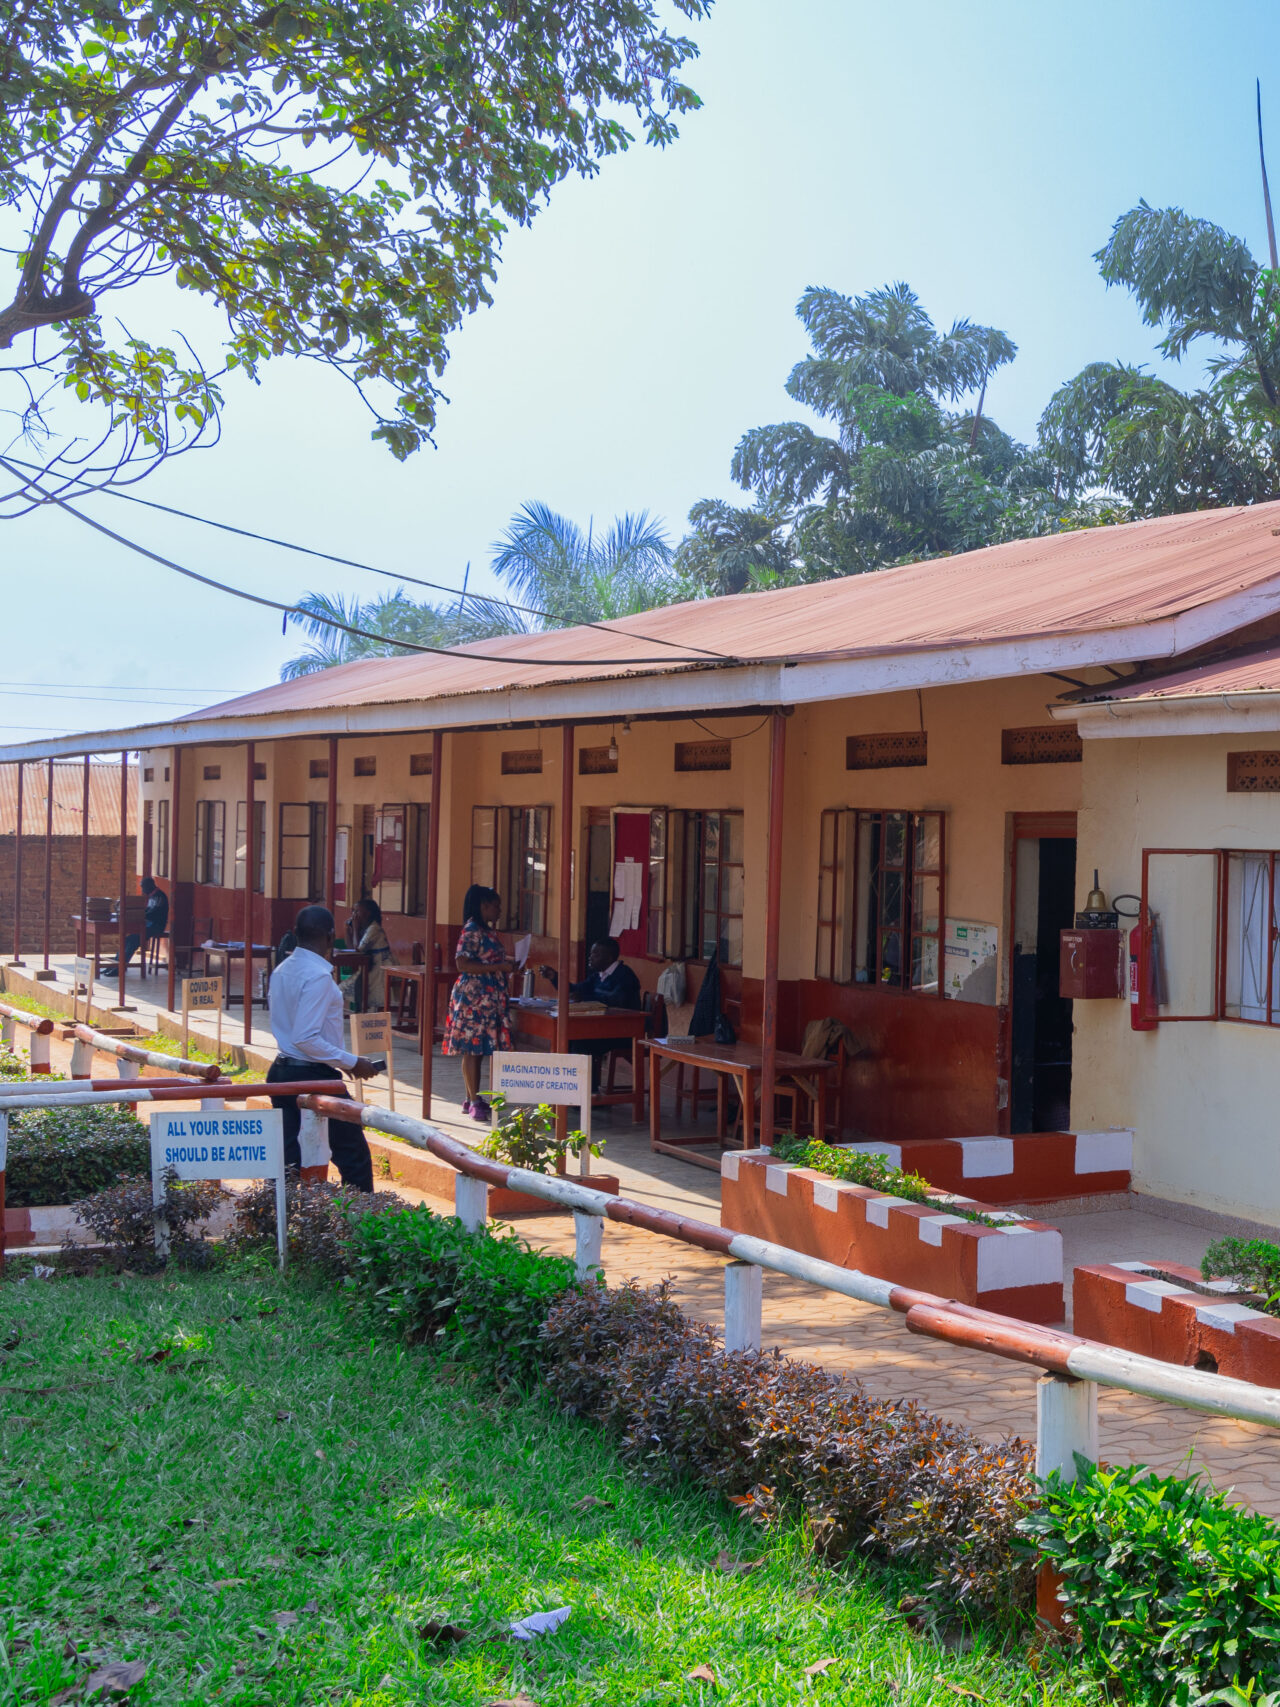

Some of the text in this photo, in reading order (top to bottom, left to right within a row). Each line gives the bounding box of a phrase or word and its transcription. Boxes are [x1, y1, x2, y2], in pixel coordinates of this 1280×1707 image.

[189, 980, 218, 993] COVID-19
[192, 995, 215, 1006] IS REAL
[502, 1064, 577, 1077] IMAGINATION IS THE
[500, 1079, 578, 1091] BEGINNING OF CREATION
[167, 1119, 263, 1137] ALL YOUR SENSES
[165, 1145, 267, 1163] SHOULD BE ACTIVE
